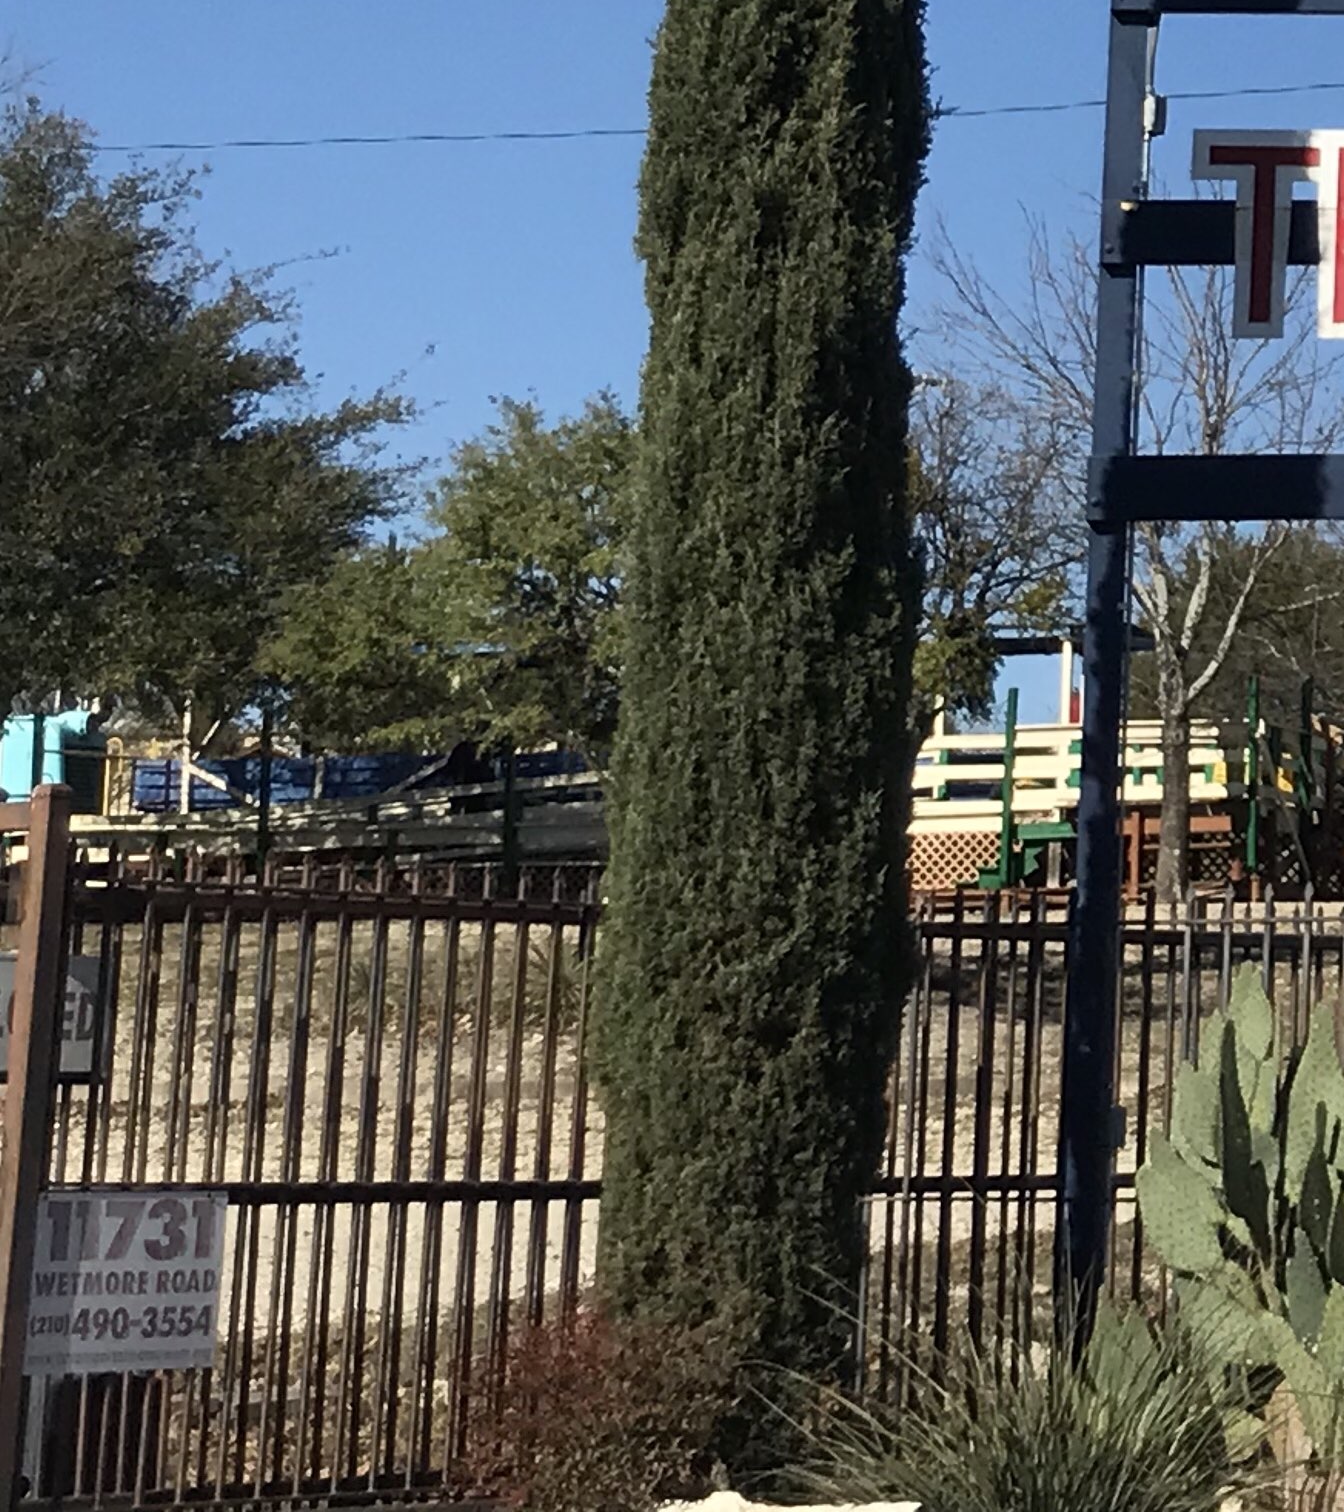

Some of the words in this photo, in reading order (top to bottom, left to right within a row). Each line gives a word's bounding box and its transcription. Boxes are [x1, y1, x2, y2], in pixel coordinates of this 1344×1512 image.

[47, 1199, 217, 1262] 11731
[34, 1271, 149, 1297] WETMORE
[155, 1268, 217, 1294] ROAD
[71, 1304, 213, 1341] 490-3554
